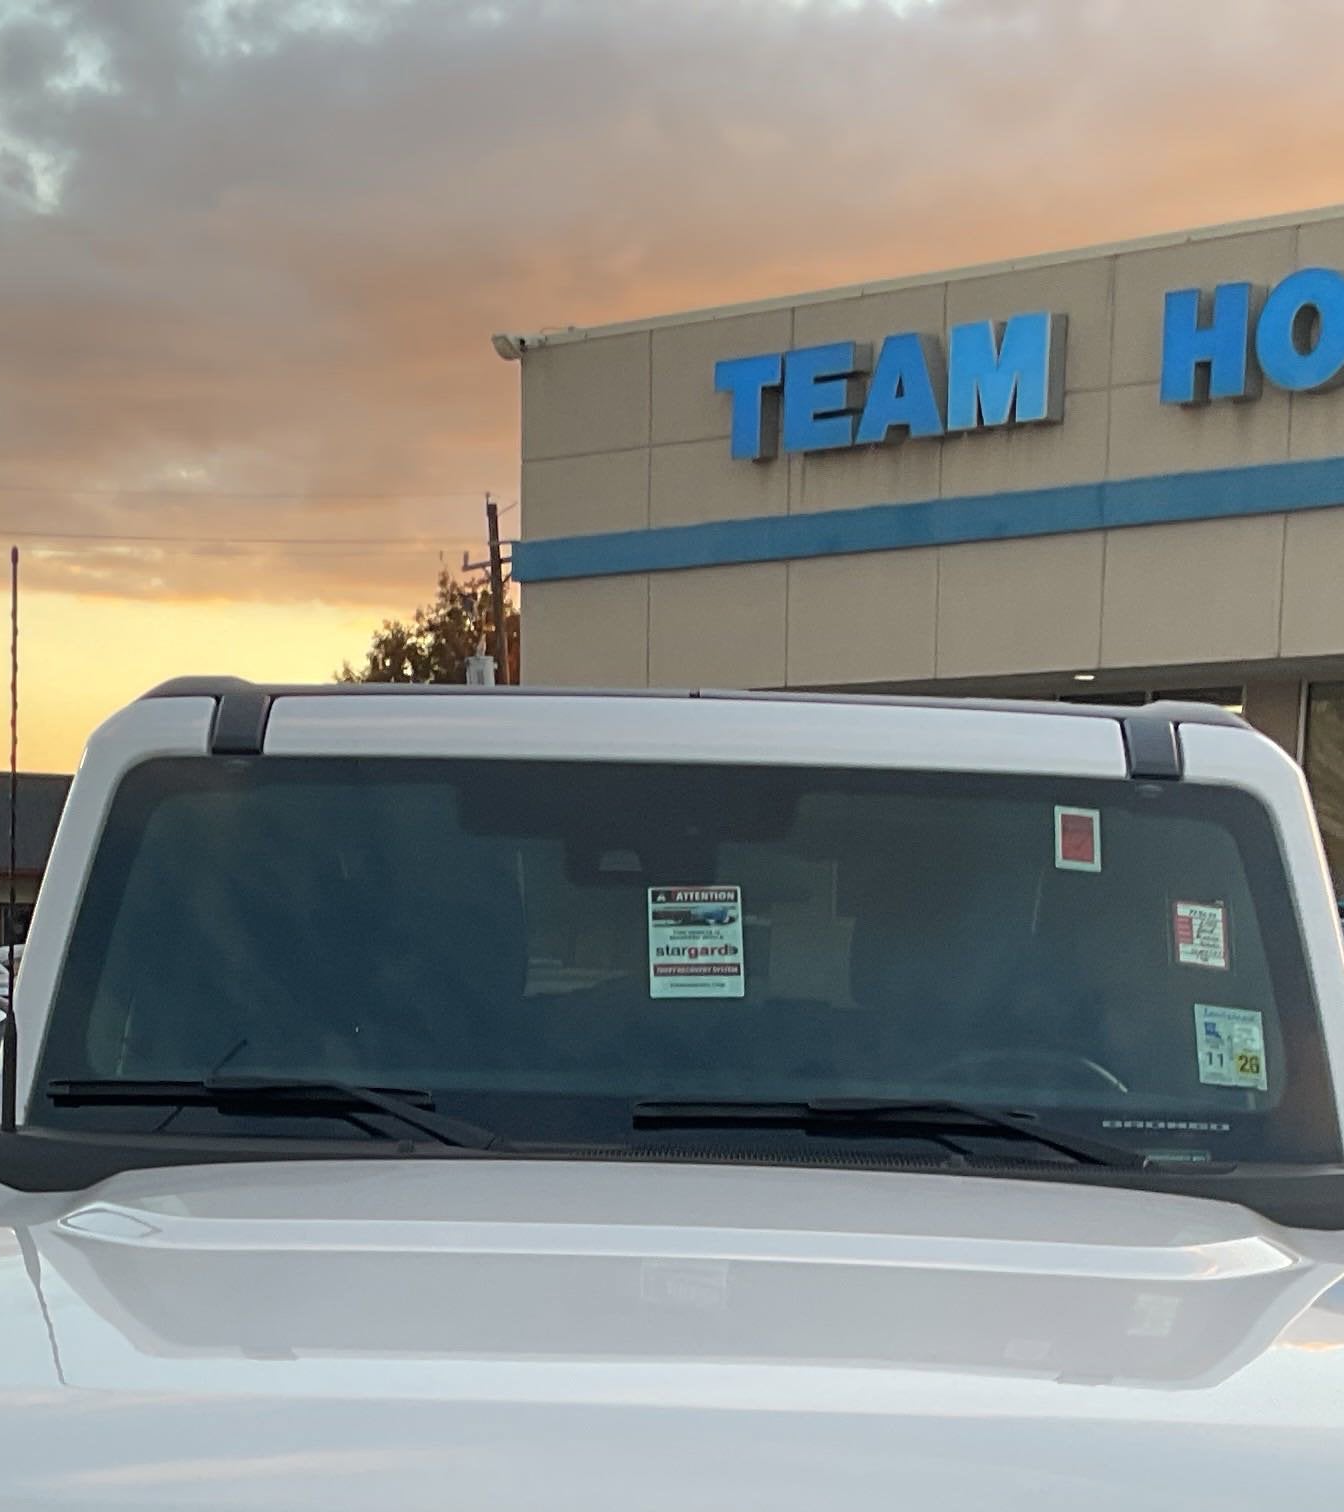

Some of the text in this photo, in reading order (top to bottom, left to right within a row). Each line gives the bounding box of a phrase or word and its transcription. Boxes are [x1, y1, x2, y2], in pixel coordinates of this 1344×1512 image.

[714, 311, 1054, 460] TEAM
[676, 891, 734, 901] ATTENTION
[1205, 1052, 1260, 1074] 11 26
